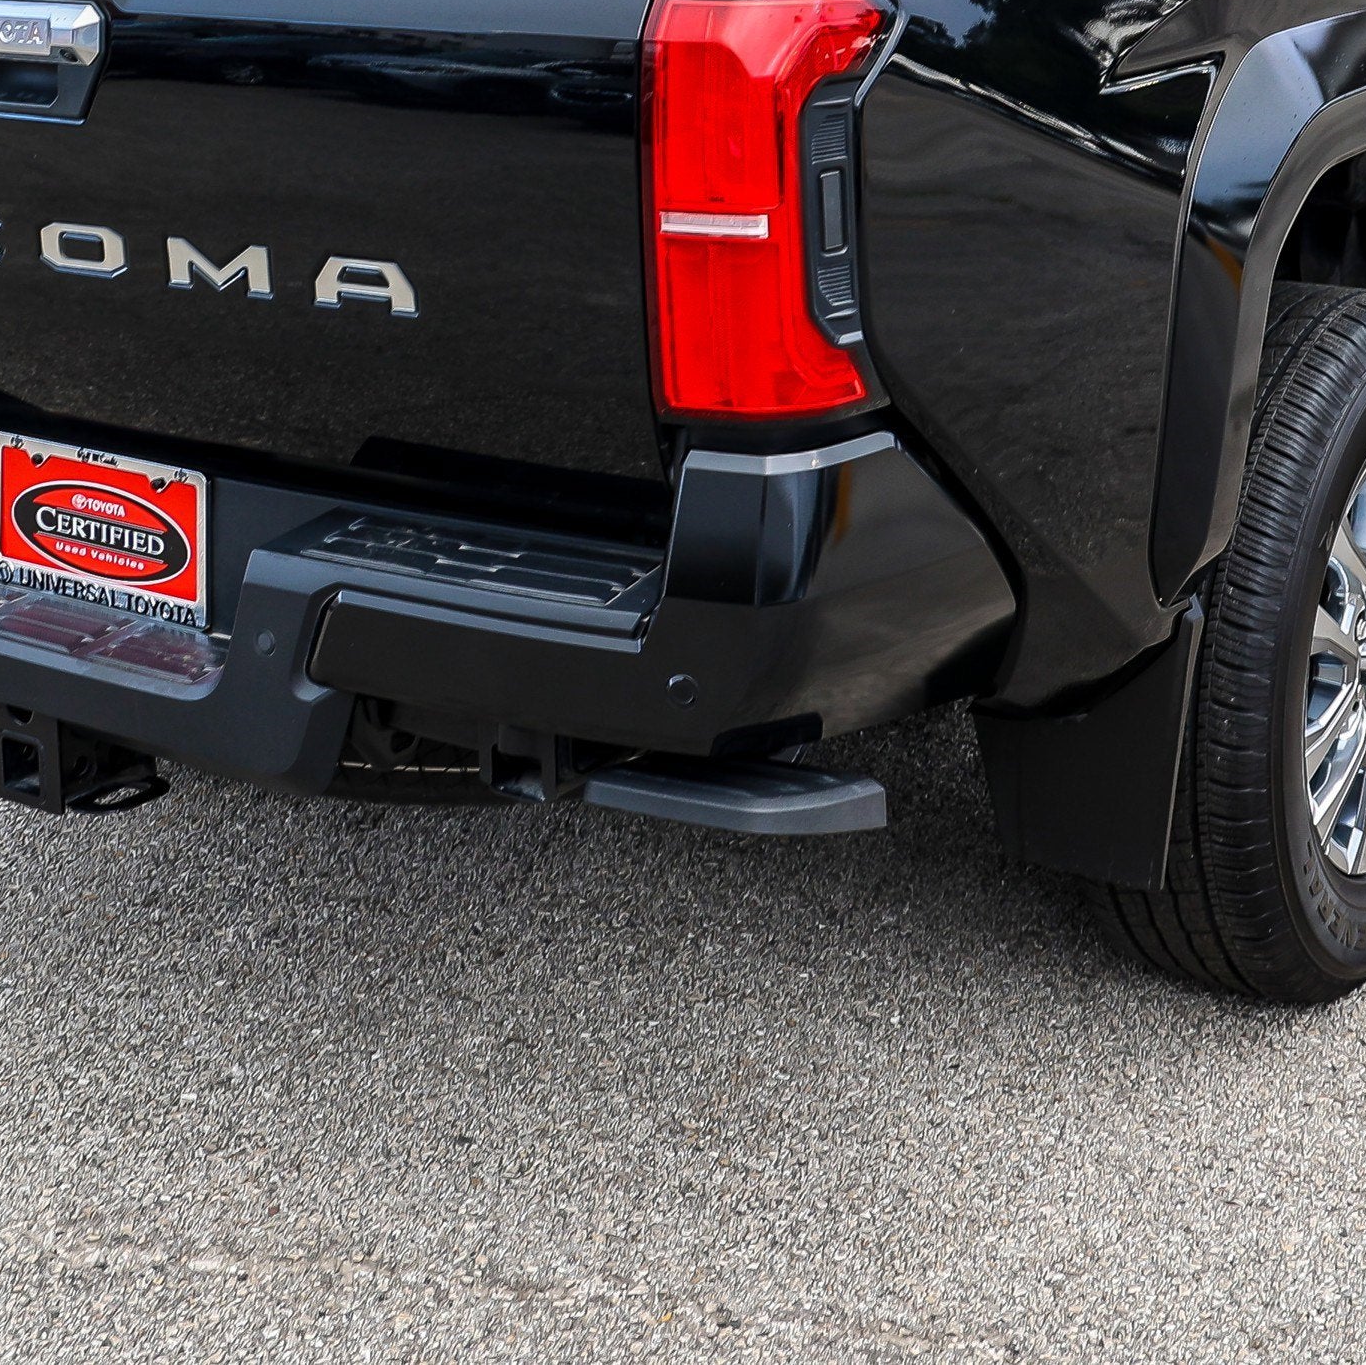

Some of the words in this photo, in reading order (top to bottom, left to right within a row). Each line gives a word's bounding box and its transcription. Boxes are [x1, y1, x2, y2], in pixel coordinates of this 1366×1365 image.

[87, 498, 126, 517] TOYOTA
[35, 506, 165, 556] CERTIFIED
[55, 541, 87, 556] Used
[90, 549, 145, 571] Vehicles
[19, 566, 123, 613] UNIVERSAL
[126, 591, 197, 626] TOYOTA
